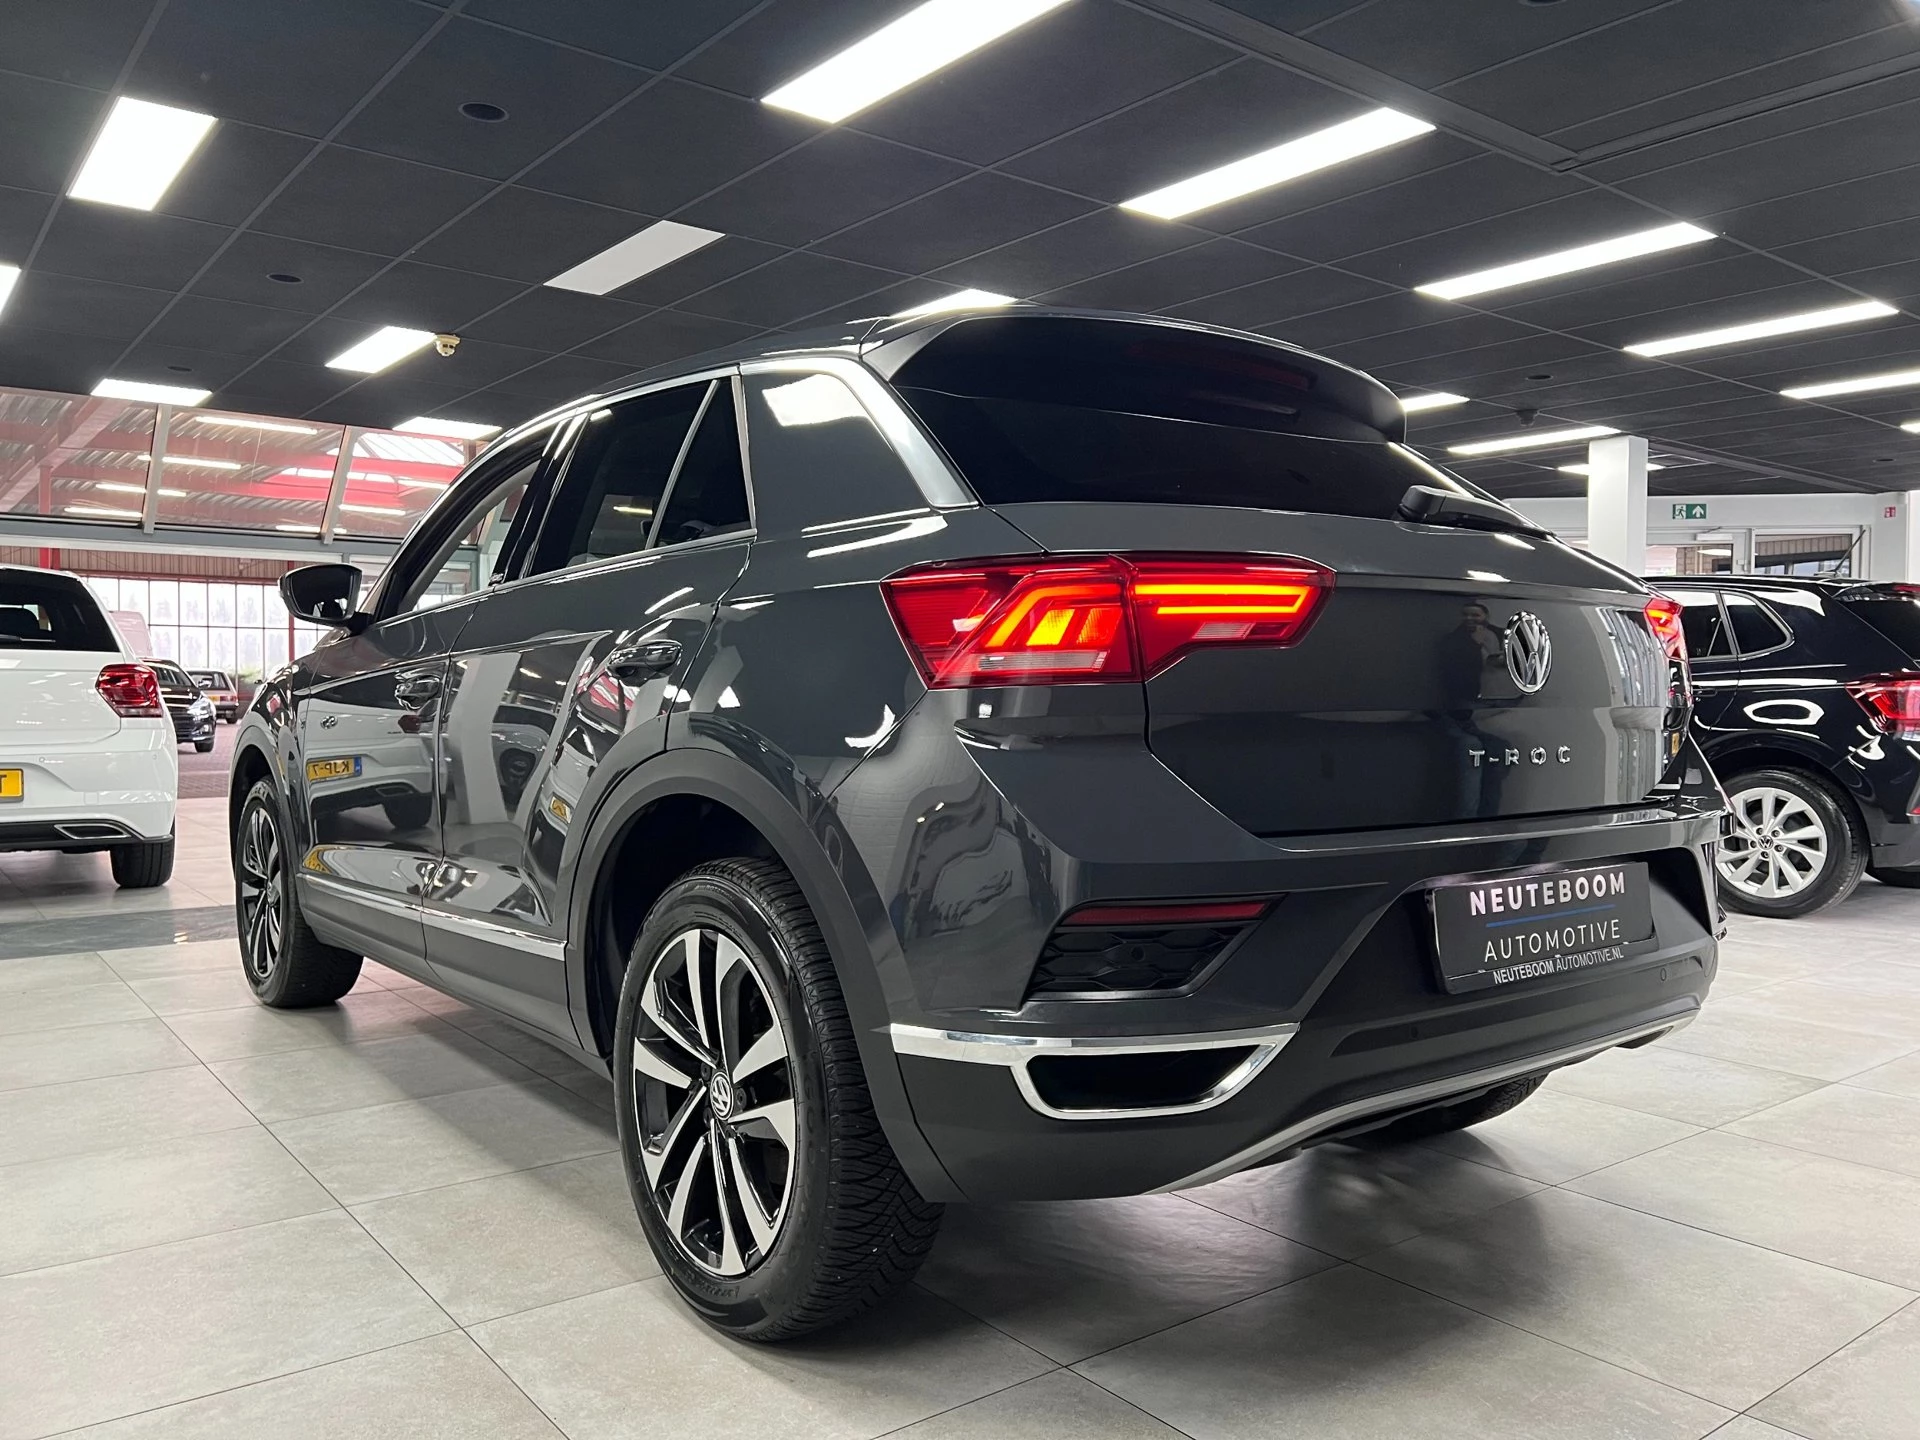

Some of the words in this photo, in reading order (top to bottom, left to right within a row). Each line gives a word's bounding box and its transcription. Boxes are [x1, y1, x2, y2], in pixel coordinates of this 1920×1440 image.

[1469, 745, 1571, 767] T-ROC
[1470, 872, 1625, 916] NEUTEBOOM
[1484, 919, 1621, 962] AUTOMOTIVE
[1493, 960, 1555, 985] NEUTEBOOM
[1556, 946, 1624, 974] AUTOMOTIVE.NL
